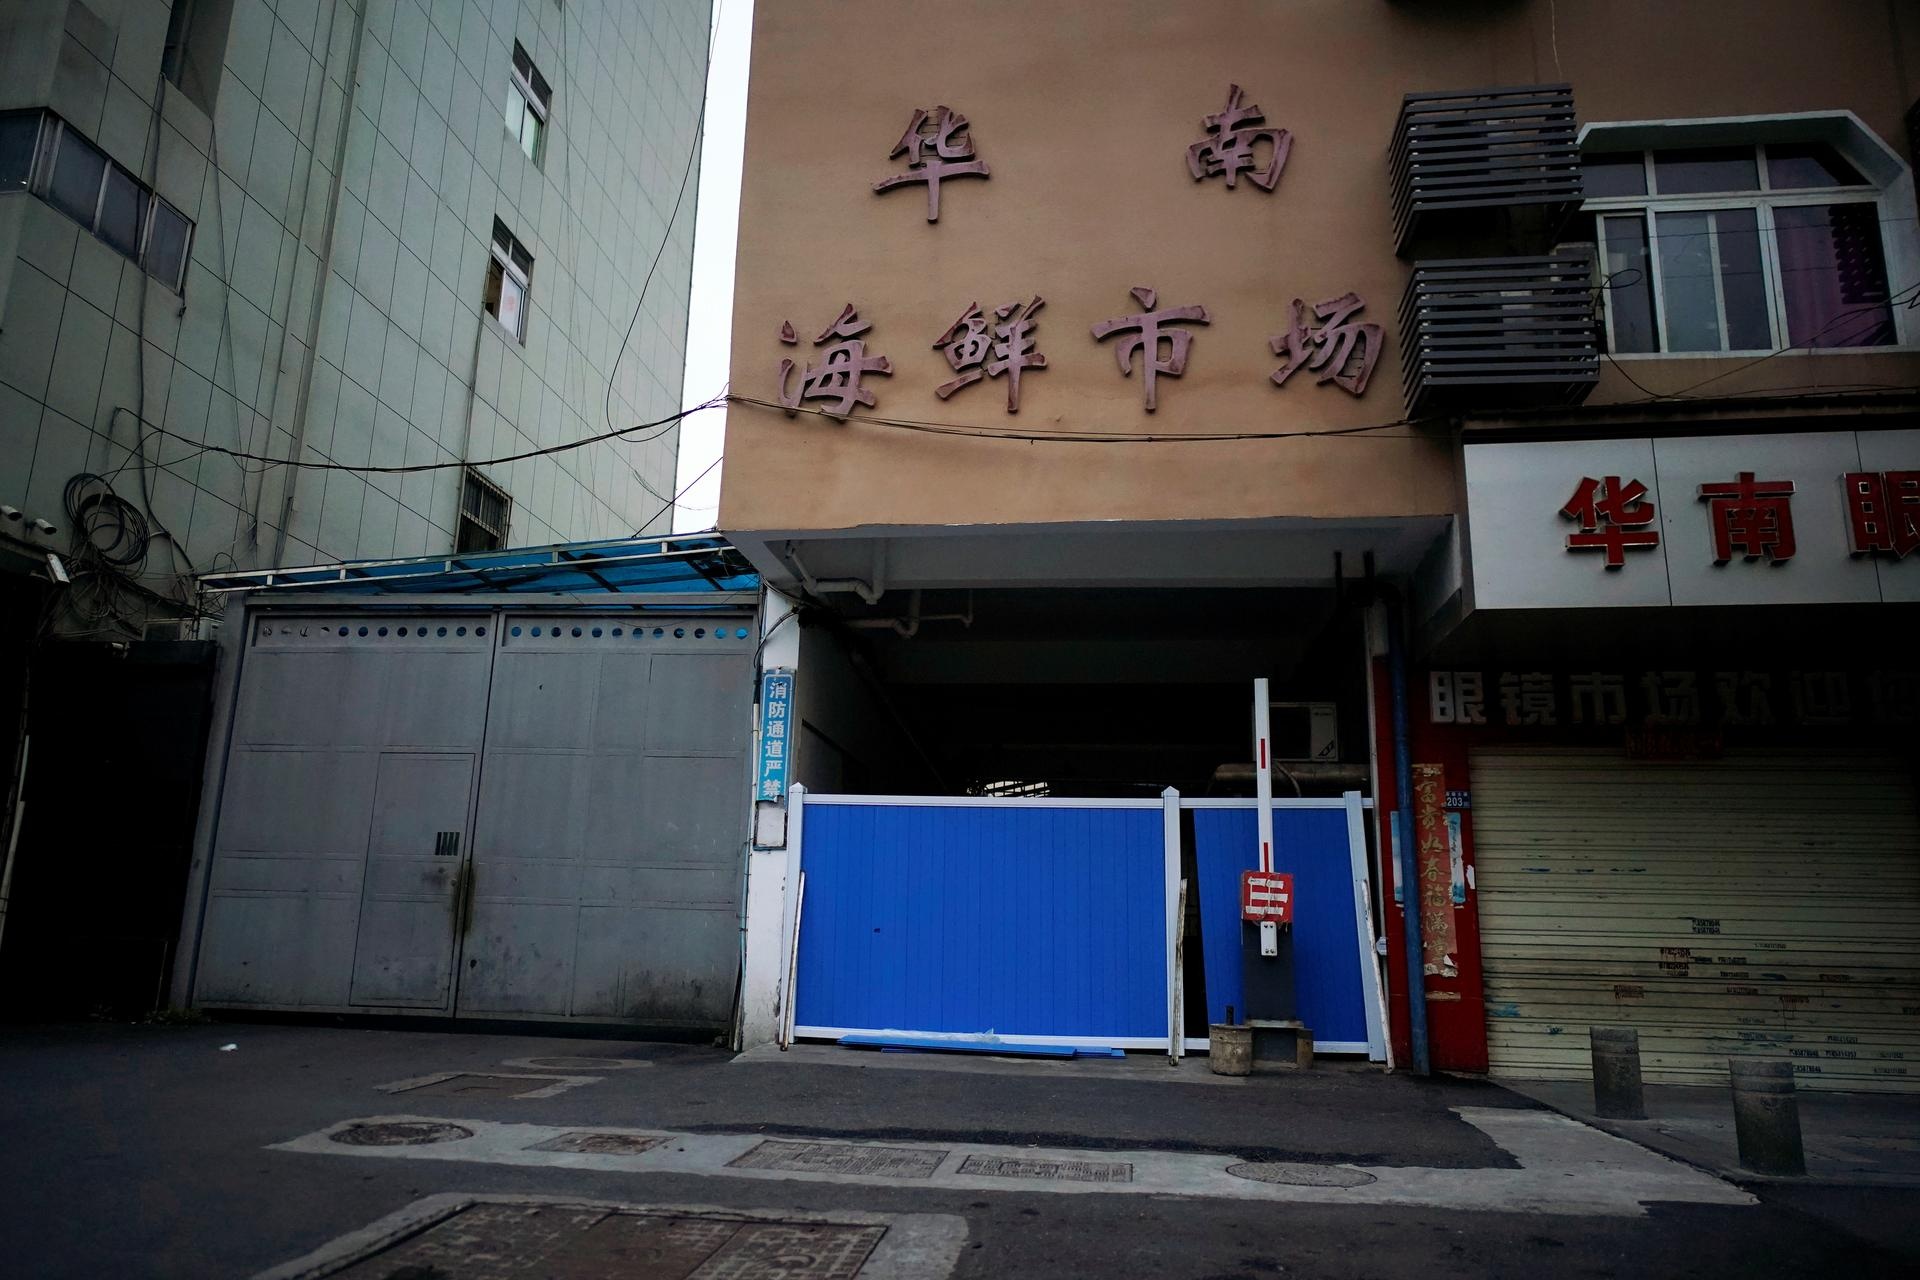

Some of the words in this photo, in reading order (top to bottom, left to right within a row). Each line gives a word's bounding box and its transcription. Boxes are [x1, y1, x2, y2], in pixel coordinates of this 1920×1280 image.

[872, 84, 1293, 224] 华南
[777, 286, 1384, 423] 海鲜市场
[763, 682, 787, 801] 消防通道严禁
[1447, 797, 1463, 807] 203
